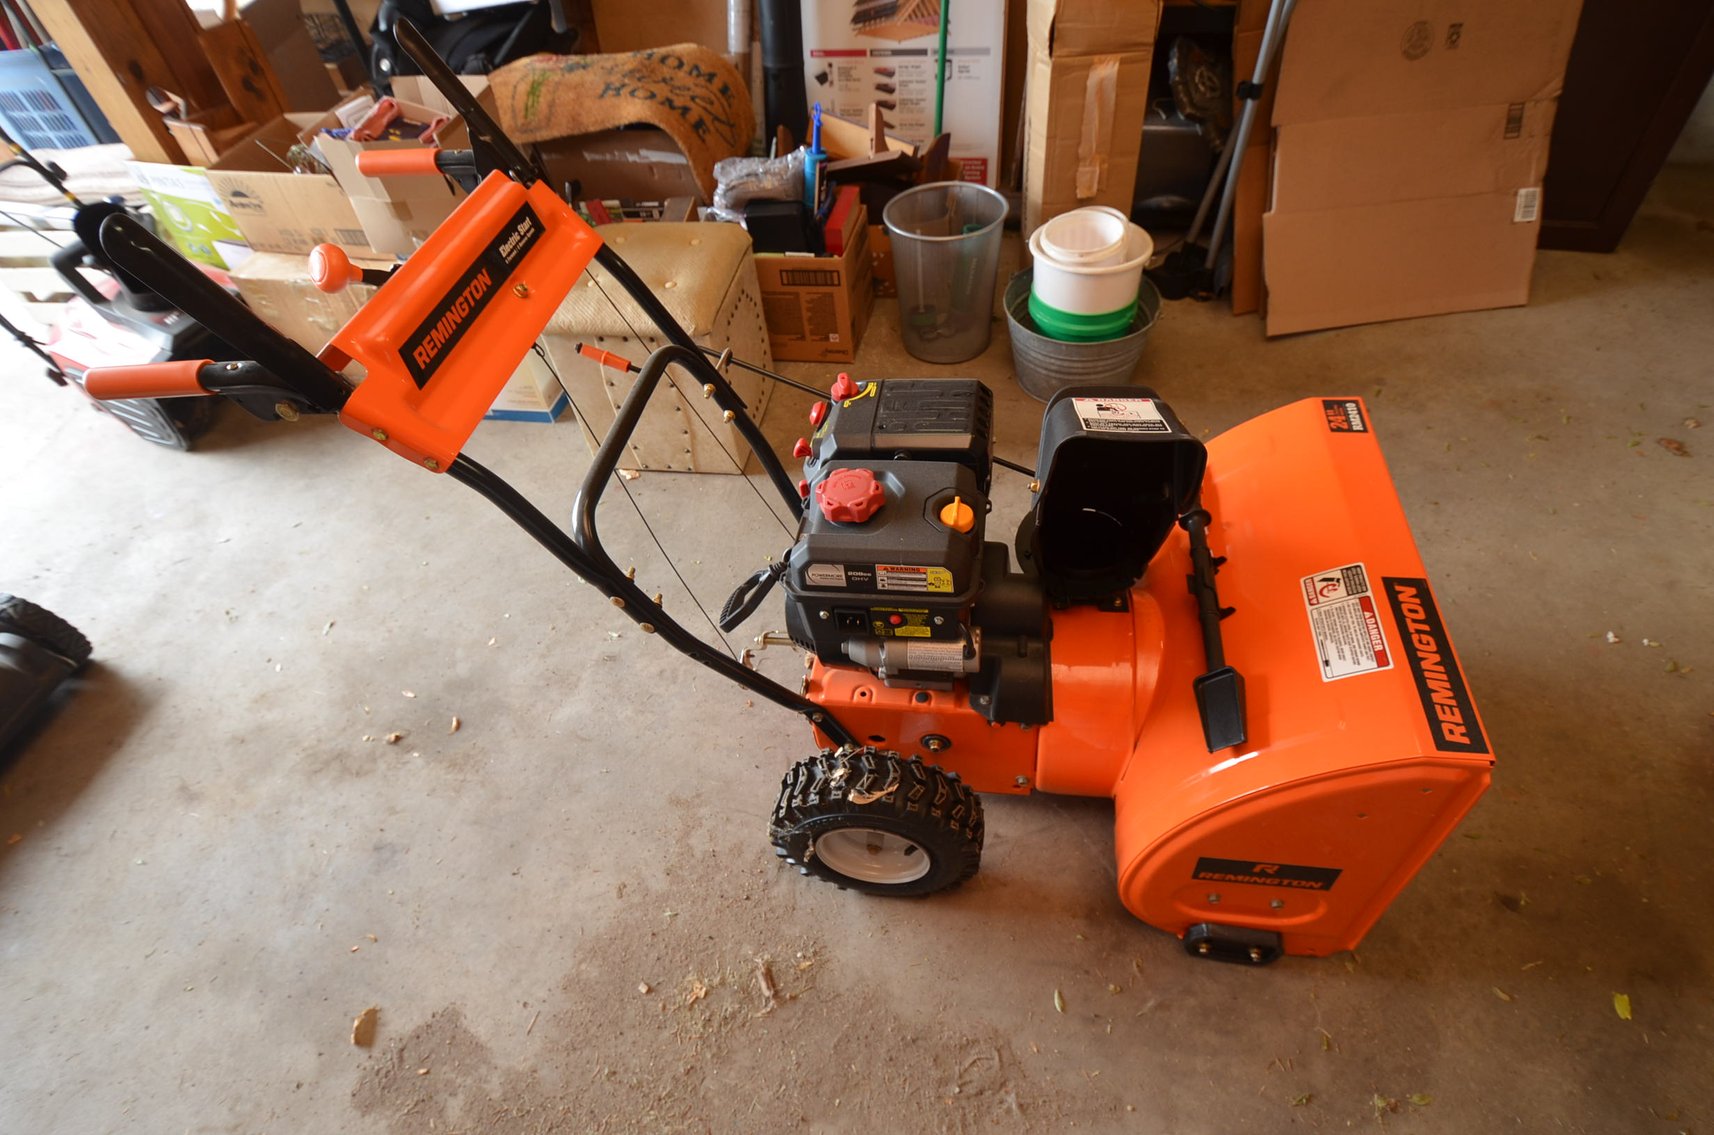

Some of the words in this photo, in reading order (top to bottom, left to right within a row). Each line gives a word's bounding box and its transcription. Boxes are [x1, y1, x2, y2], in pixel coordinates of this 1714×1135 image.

[600, 81, 710, 144] HOME
[499, 231, 520, 258] Electric
[517, 216, 532, 236] Start
[412, 268, 493, 370] REMINGTON
[1345, 402, 1364, 430] RM2410
[1366, 618, 1383, 651] DANGER
[1395, 585, 1471, 744] REMINGTON
[1198, 872, 1324, 888] REMINGTON
